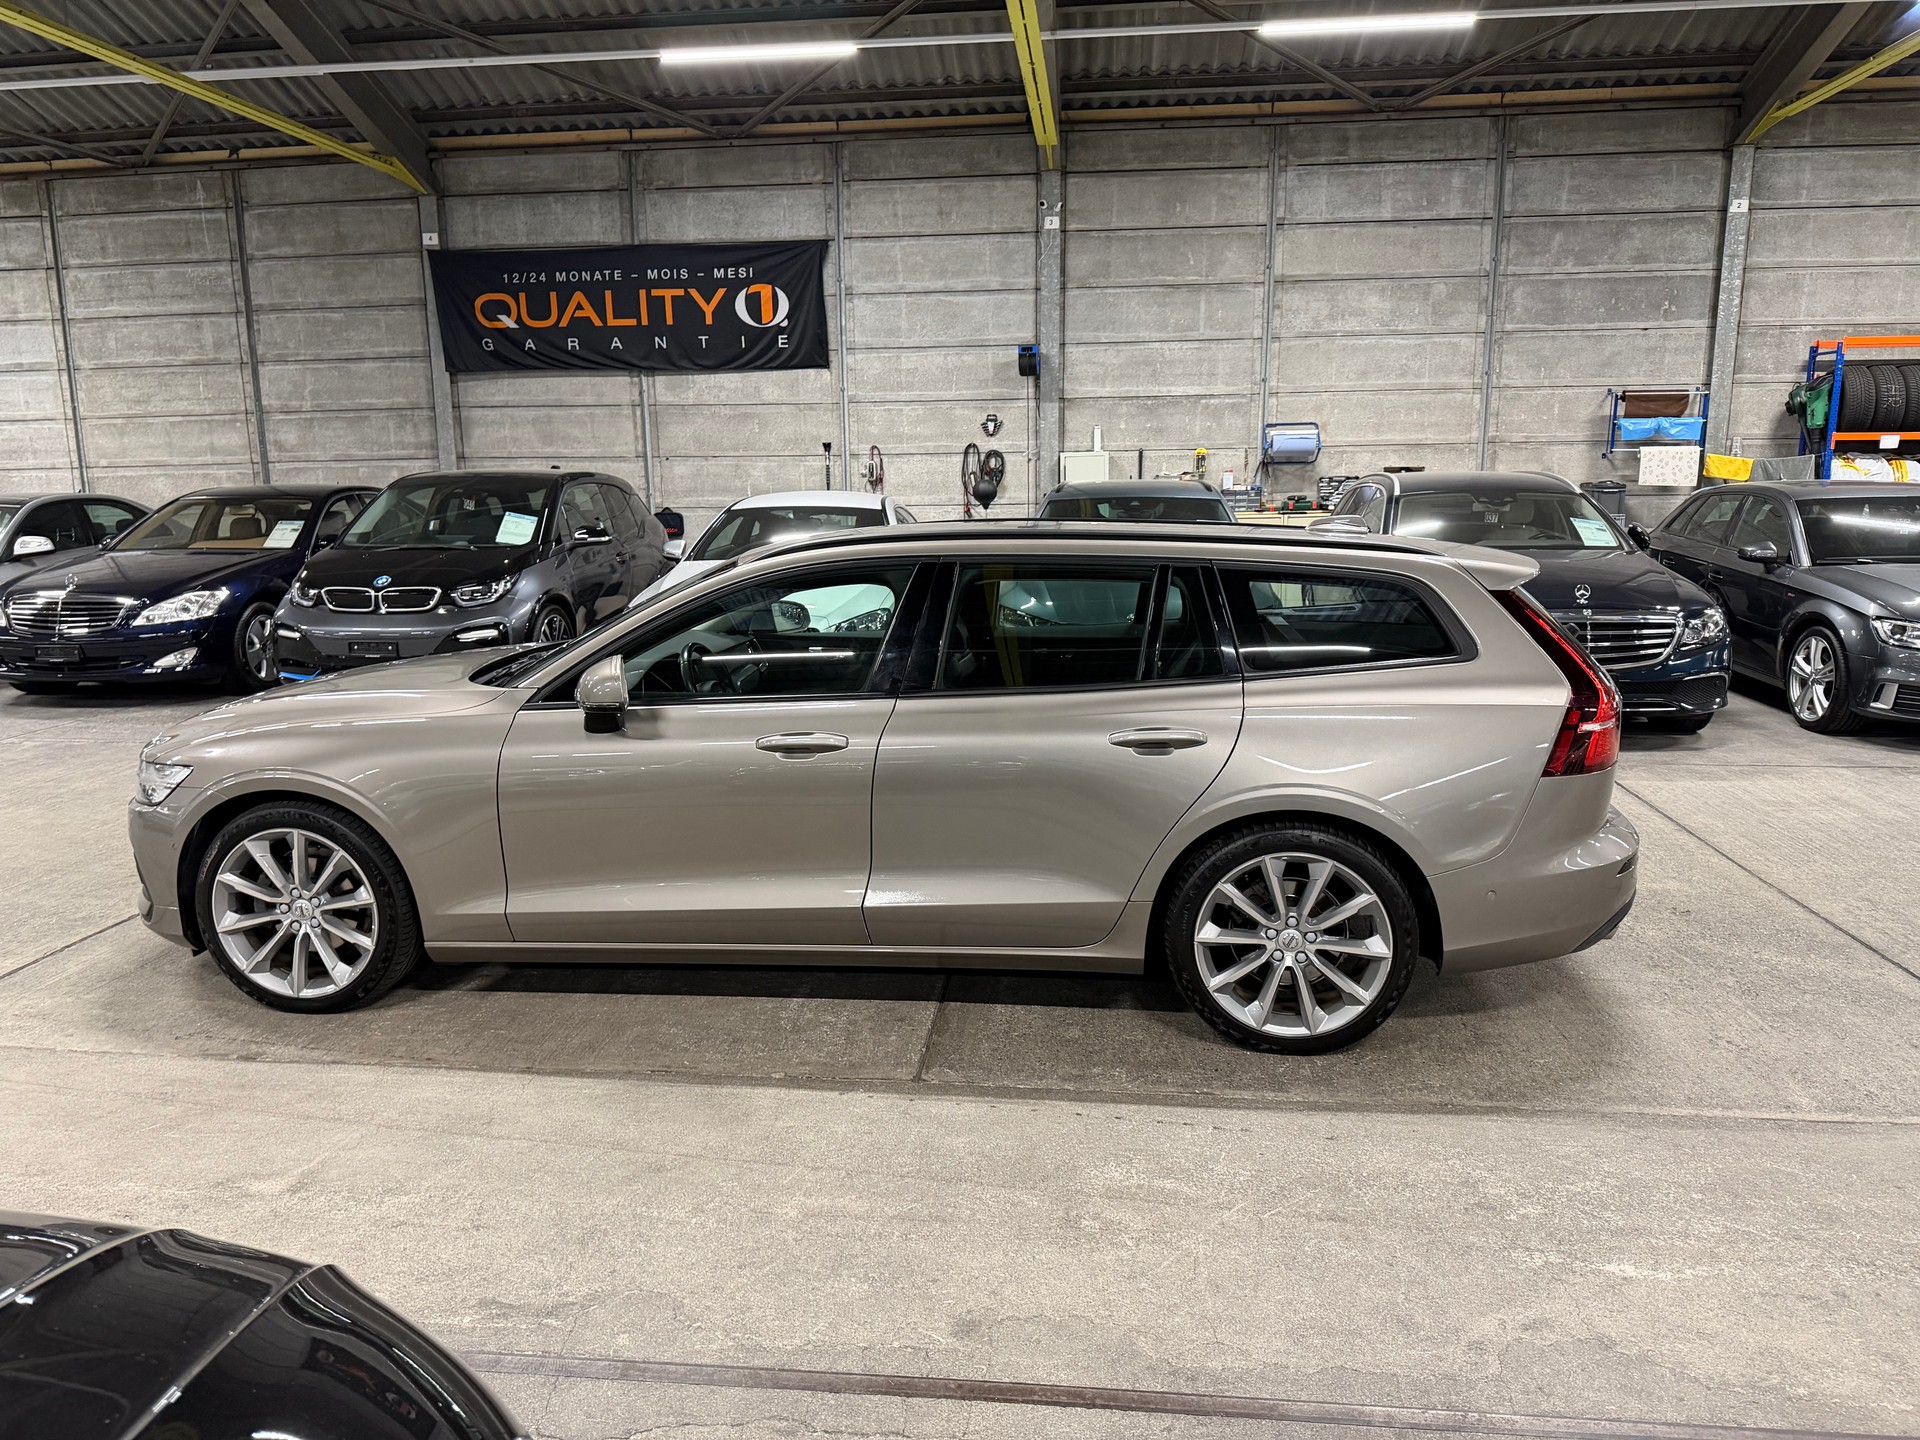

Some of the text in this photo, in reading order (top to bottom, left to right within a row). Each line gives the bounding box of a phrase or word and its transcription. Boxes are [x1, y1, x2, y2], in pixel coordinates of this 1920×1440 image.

[502, 272, 547, 284] 12/24
[555, 269, 623, 282] MONATE
[647, 268, 689, 280] MOIS
[713, 266, 753, 279] MESI
[474, 287, 728, 329] QUALITY
[482, 334, 789, 351] GARANTIE
